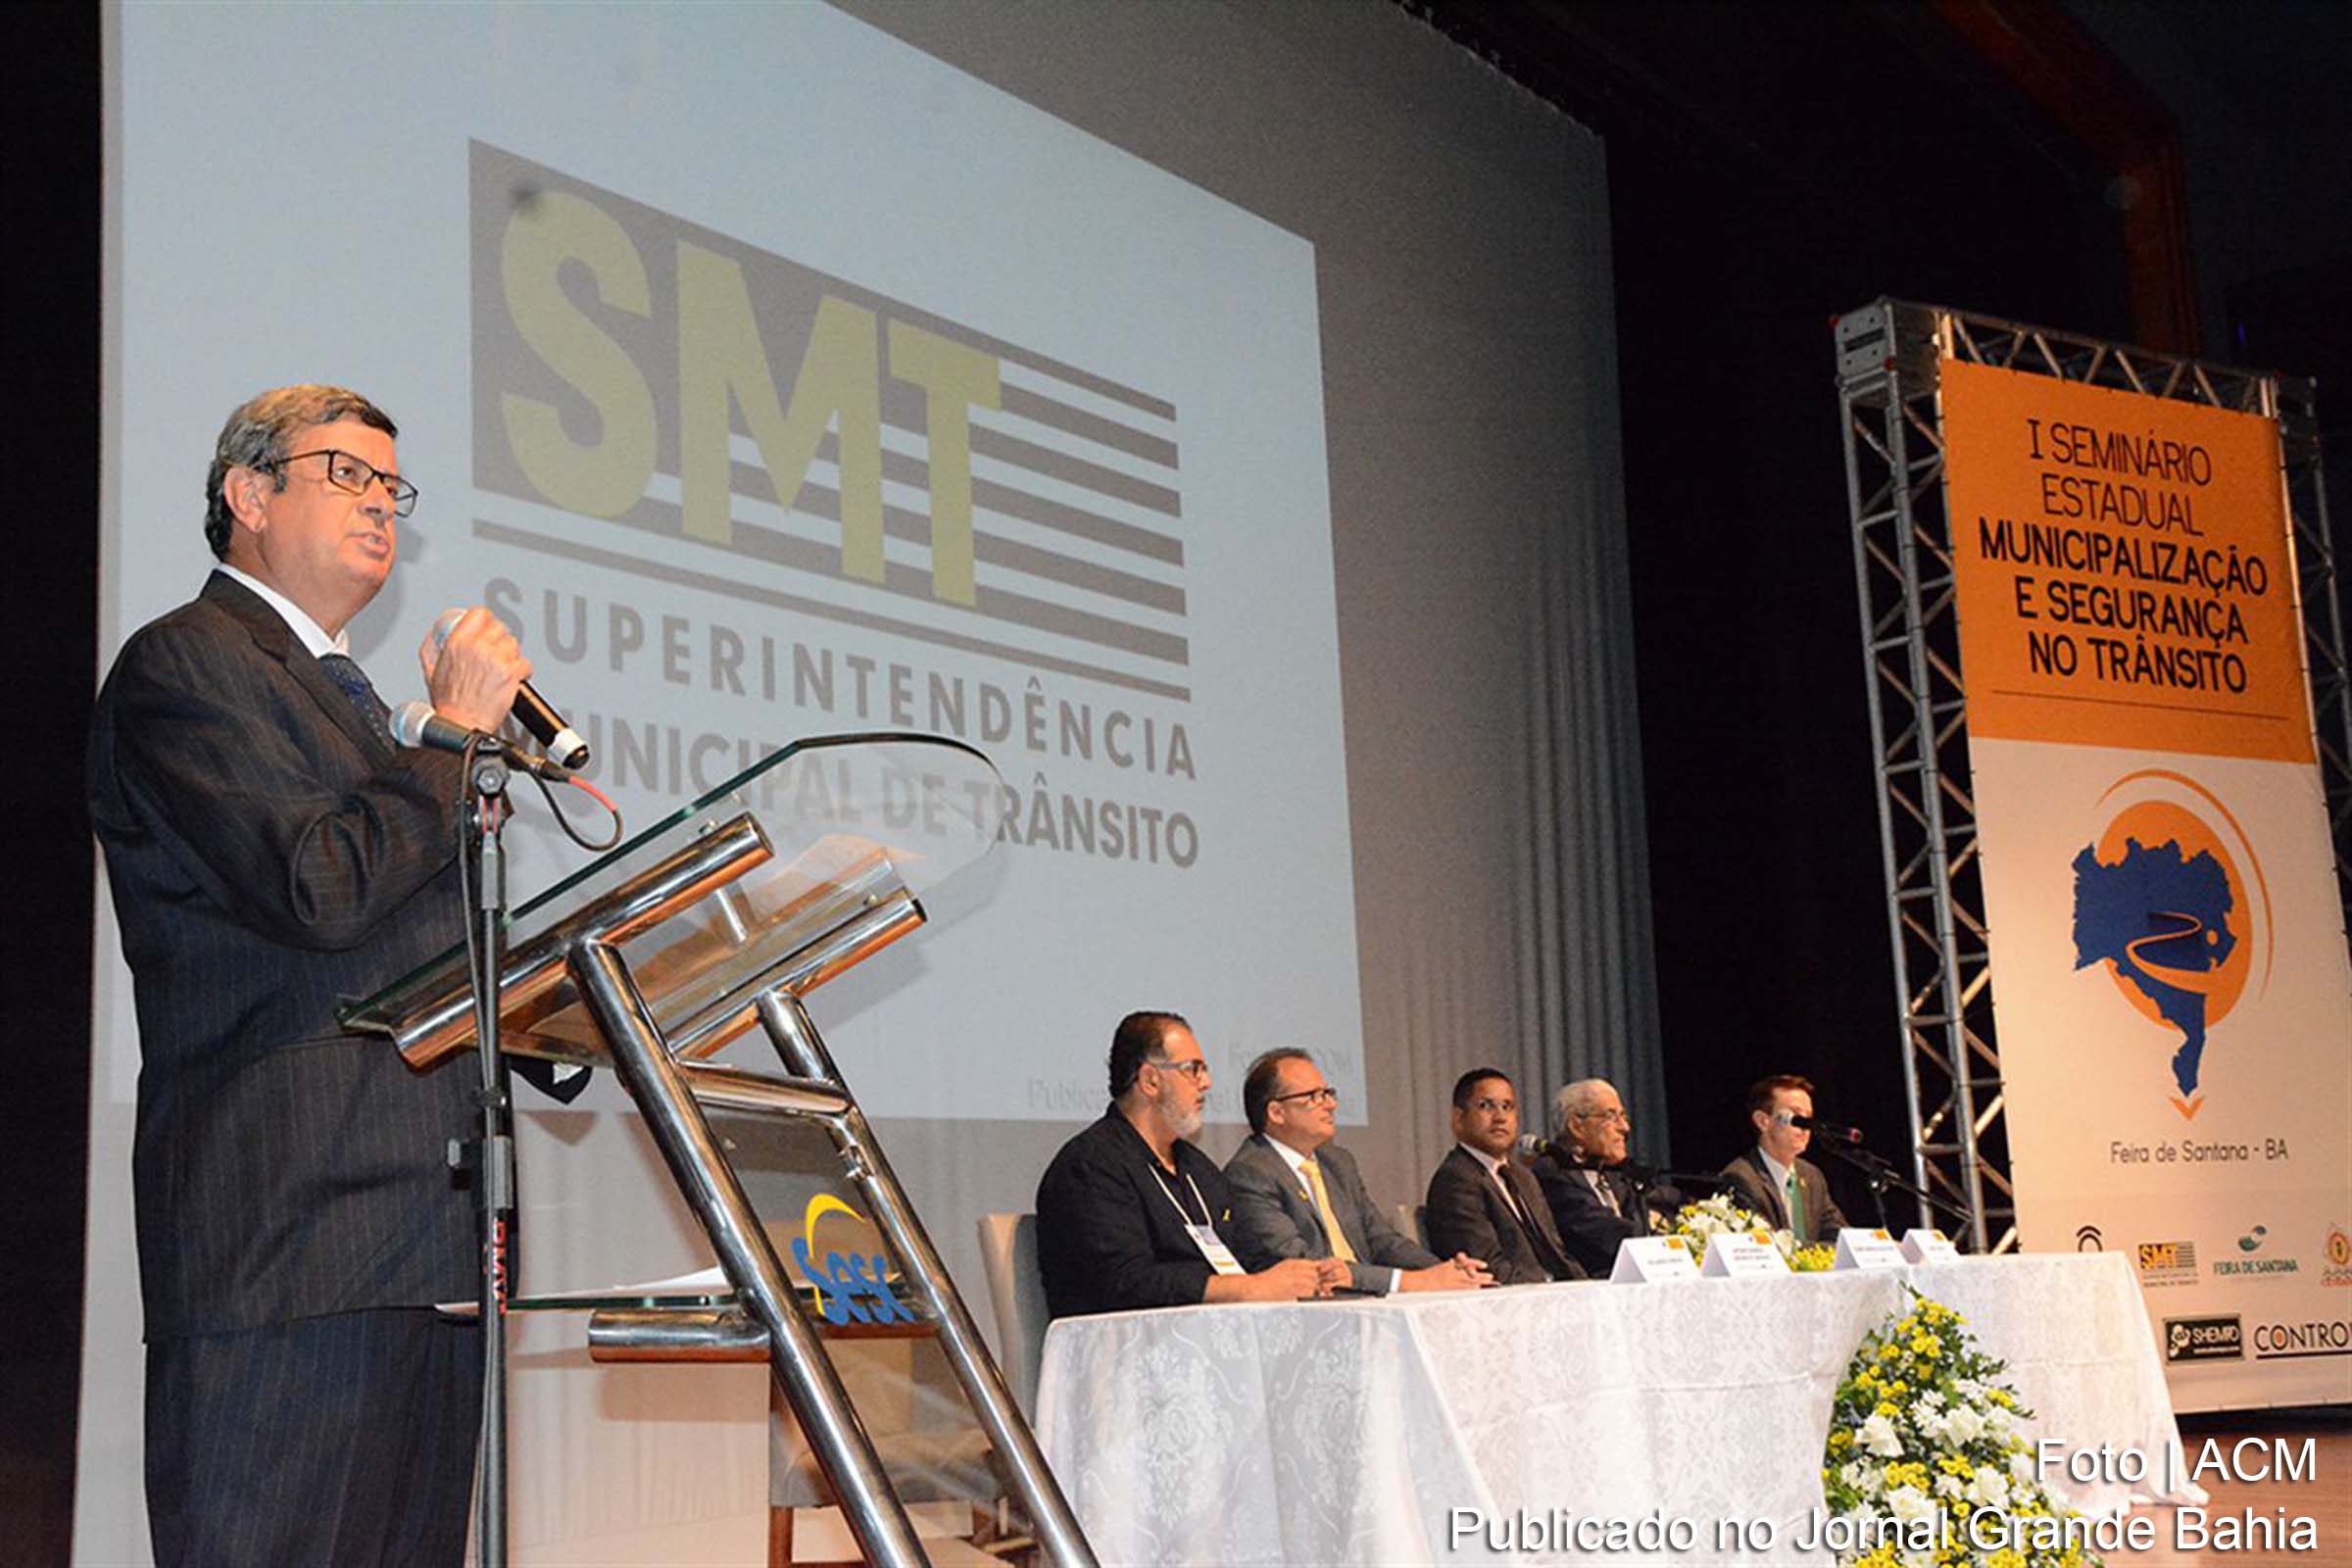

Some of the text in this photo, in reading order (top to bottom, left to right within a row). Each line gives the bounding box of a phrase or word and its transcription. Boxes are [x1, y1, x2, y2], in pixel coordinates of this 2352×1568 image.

[501, 193, 1003, 608] SMT
[2028, 418, 2212, 486] I SEMINÁRIO
[2041, 473, 2204, 537] ESTADUAL
[1979, 516, 2268, 599] MUNICIPALIZAÇÃO
[2014, 576, 2249, 649] E SEGURANÇA
[483, 576, 1197, 780] SUPERINTENDÊNCIA
[2028, 632, 2247, 694] NO TRÂNSITO
[880, 766, 948, 836] DE
[963, 770, 1200, 869] TRÂNSITO
[2110, 1142, 2150, 1163] Feira
[2156, 1142, 2177, 1162] de
[2181, 1141, 2248, 1162] Santana
[2266, 1139, 2289, 1160] BA
[2140, 1243, 2178, 1269] SMT
[2254, 1322, 2352, 1352] CONTRO
